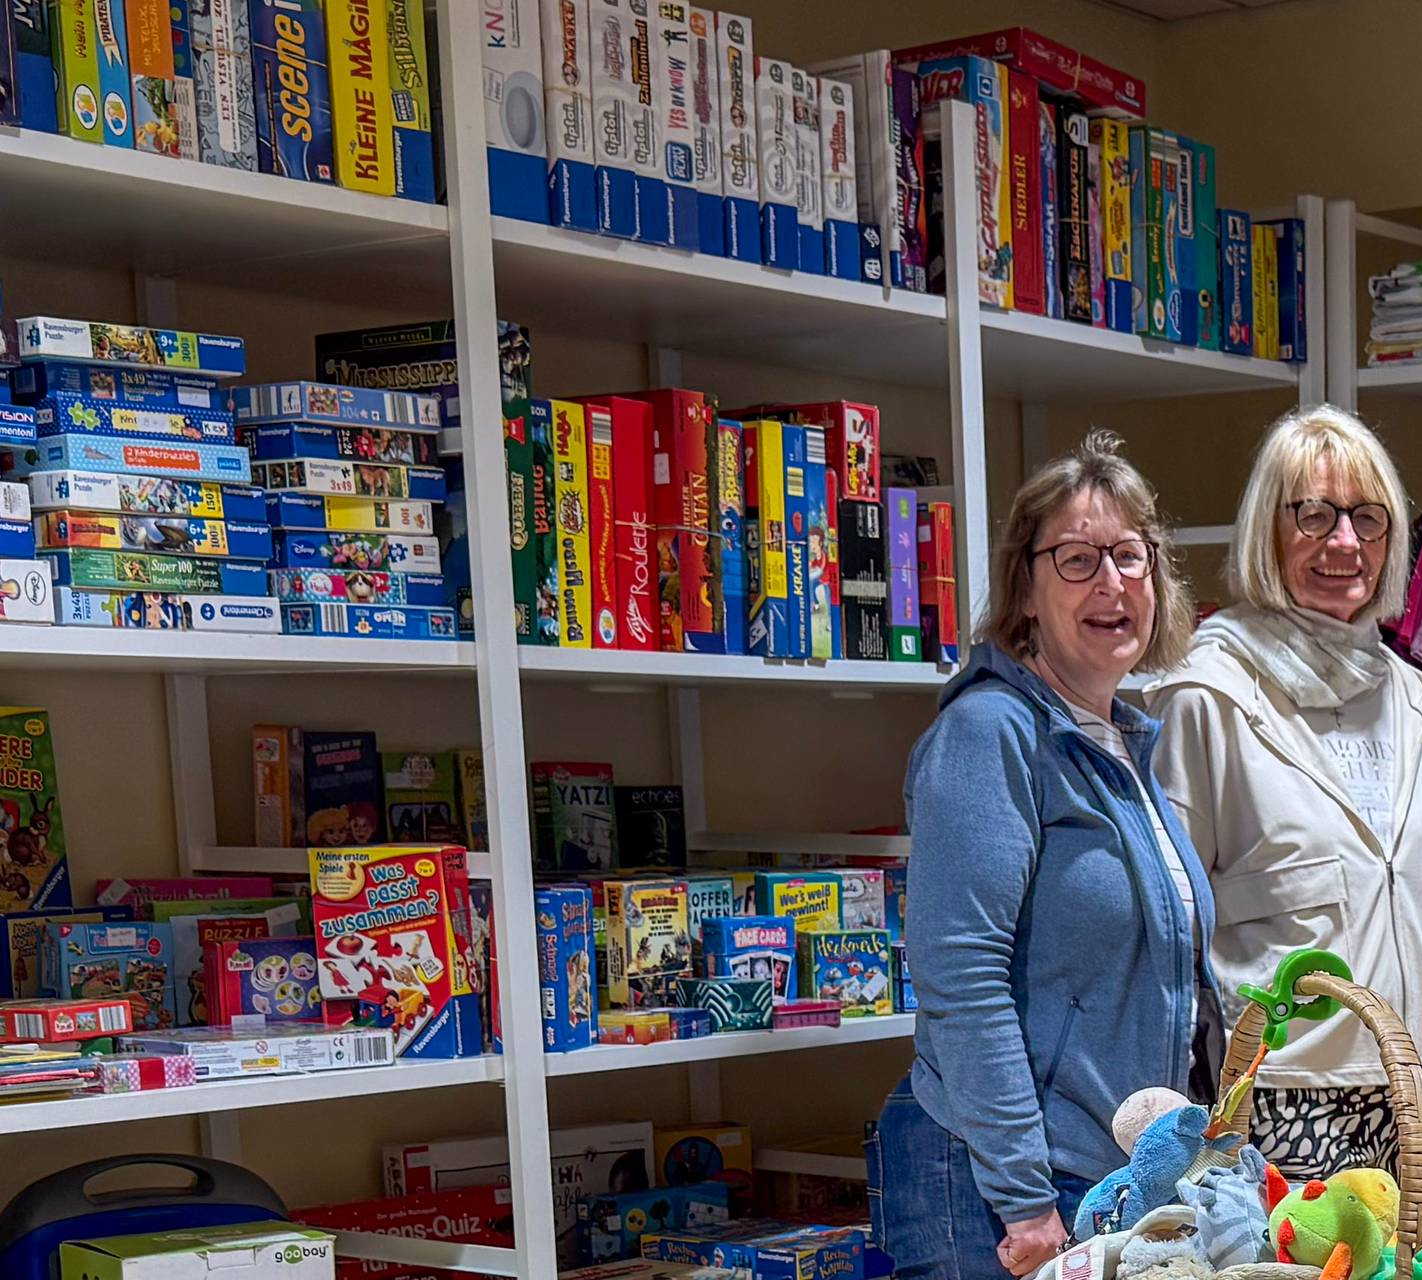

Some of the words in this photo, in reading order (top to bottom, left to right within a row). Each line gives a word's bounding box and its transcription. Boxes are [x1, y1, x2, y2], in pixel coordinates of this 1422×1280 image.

[275, 14, 313, 143] scene
[563, 103, 580, 149] tiptoi
[603, 111, 620, 156] tiptoi
[668, 108, 689, 130] YES
[394, 129, 404, 193] Ravensburger
[634, 119, 649, 165] tiptoi
[562, 162, 570, 223] Ravensburger
[603, 169, 611, 229] Ravensburger
[1014, 155, 1028, 232] SIEDLER
[1070, 147, 1080, 261] ESCHNAPUR
[1180, 182, 1188, 230] Scotland
[667, 186, 675, 244] Ravensburger
[43, 321, 86, 335] Ravensburger
[43, 331, 64, 341] Puzzle
[199, 336, 241, 349] Ravensburger
[121, 371, 146, 385] 3x49
[557, 410, 572, 456] HABA
[227, 523, 269, 535] Ravensburger
[510, 471, 528, 551] QUEEN
[682, 486, 690, 530] IEDLER
[692, 473, 709, 547] CATAN
[151, 559, 176, 574] Super
[178, 561, 192, 573] 100
[562, 537, 584, 588] HERO
[792, 546, 803, 595] KRAKE
[73, 591, 82, 620] 3x48
[221, 605, 265, 617] Clementoni
[373, 610, 406, 627] NEMO
[563, 588, 584, 641] RHINO
[555, 785, 610, 805] YATZI
[316, 851, 342, 861] Meine
[343, 852, 370, 861] ersten
[319, 862, 343, 876] Spiele
[370, 862, 405, 883] Was
[33, 865, 65, 910] Ravensburger
[366, 876, 419, 908] passt
[691, 891, 730, 908] OFFER
[780, 889, 805, 906] Wer's
[807, 885, 831, 901] weiß
[785, 898, 830, 918] gewinnt!
[320, 890, 440, 938] zusammen?
[734, 929, 758, 947] FACE
[759, 927, 787, 946] CARDS
[412, 1008, 451, 1054] Ravensburger
[454, 1000, 463, 1055] Ravensburger
[274, 1244, 328, 1264] goobay
[757, 1251, 794, 1264] Ravensburger
